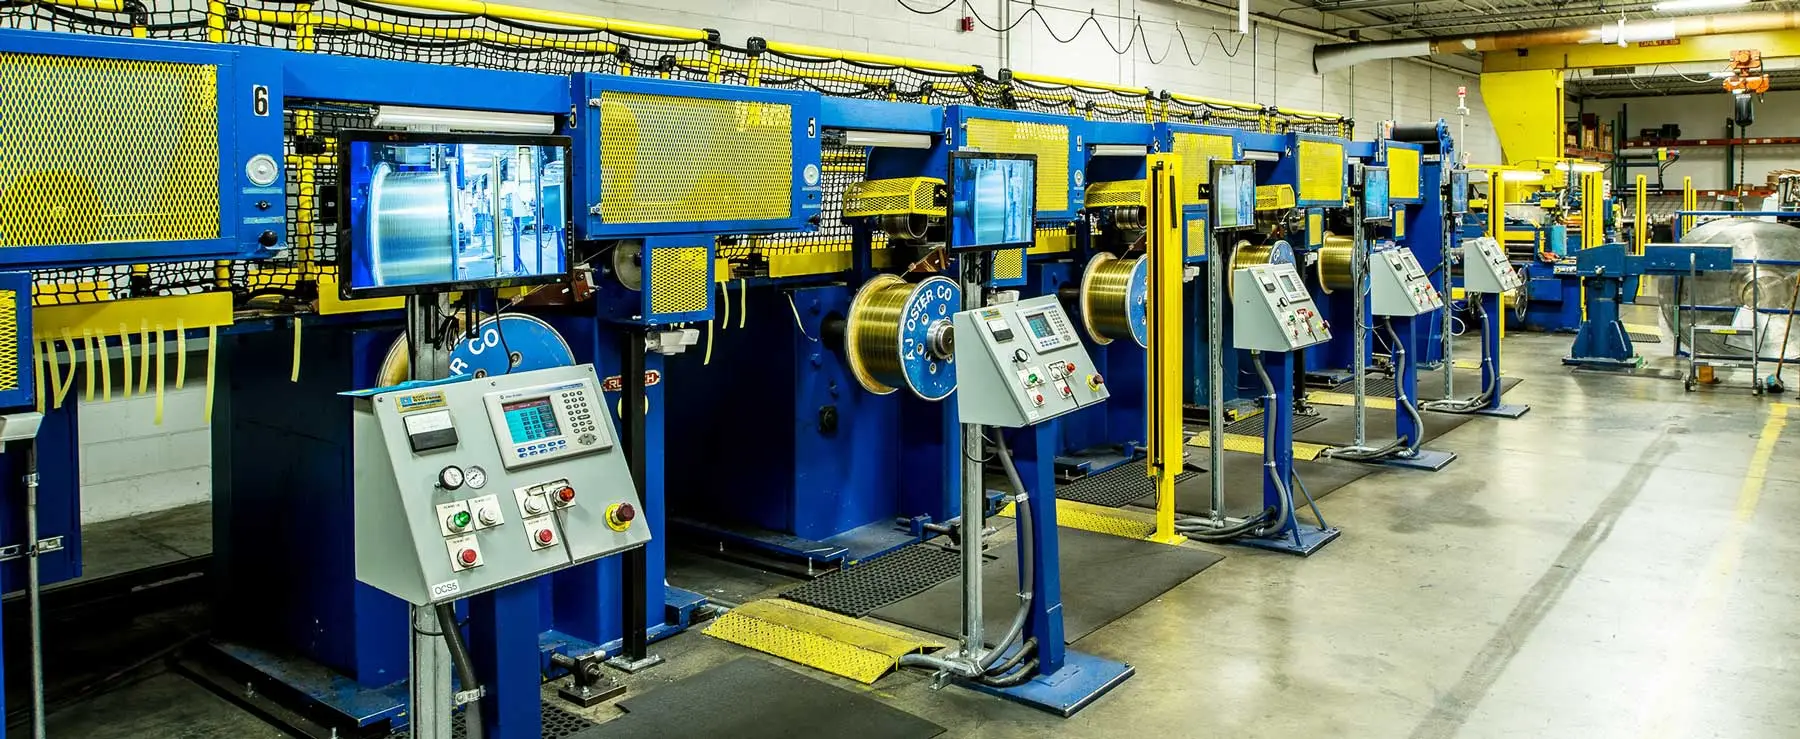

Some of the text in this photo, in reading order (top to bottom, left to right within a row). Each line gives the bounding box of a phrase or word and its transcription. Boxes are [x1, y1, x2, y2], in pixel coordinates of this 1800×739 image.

[254, 86, 268, 115] 6
[808, 117, 815, 137] 5
[945, 127, 952, 145] 4
[906, 289, 934, 332] OSTER
[936, 285, 952, 301] CO
[468, 328, 499, 355] CO
[434, 582, 458, 596] OCS5
